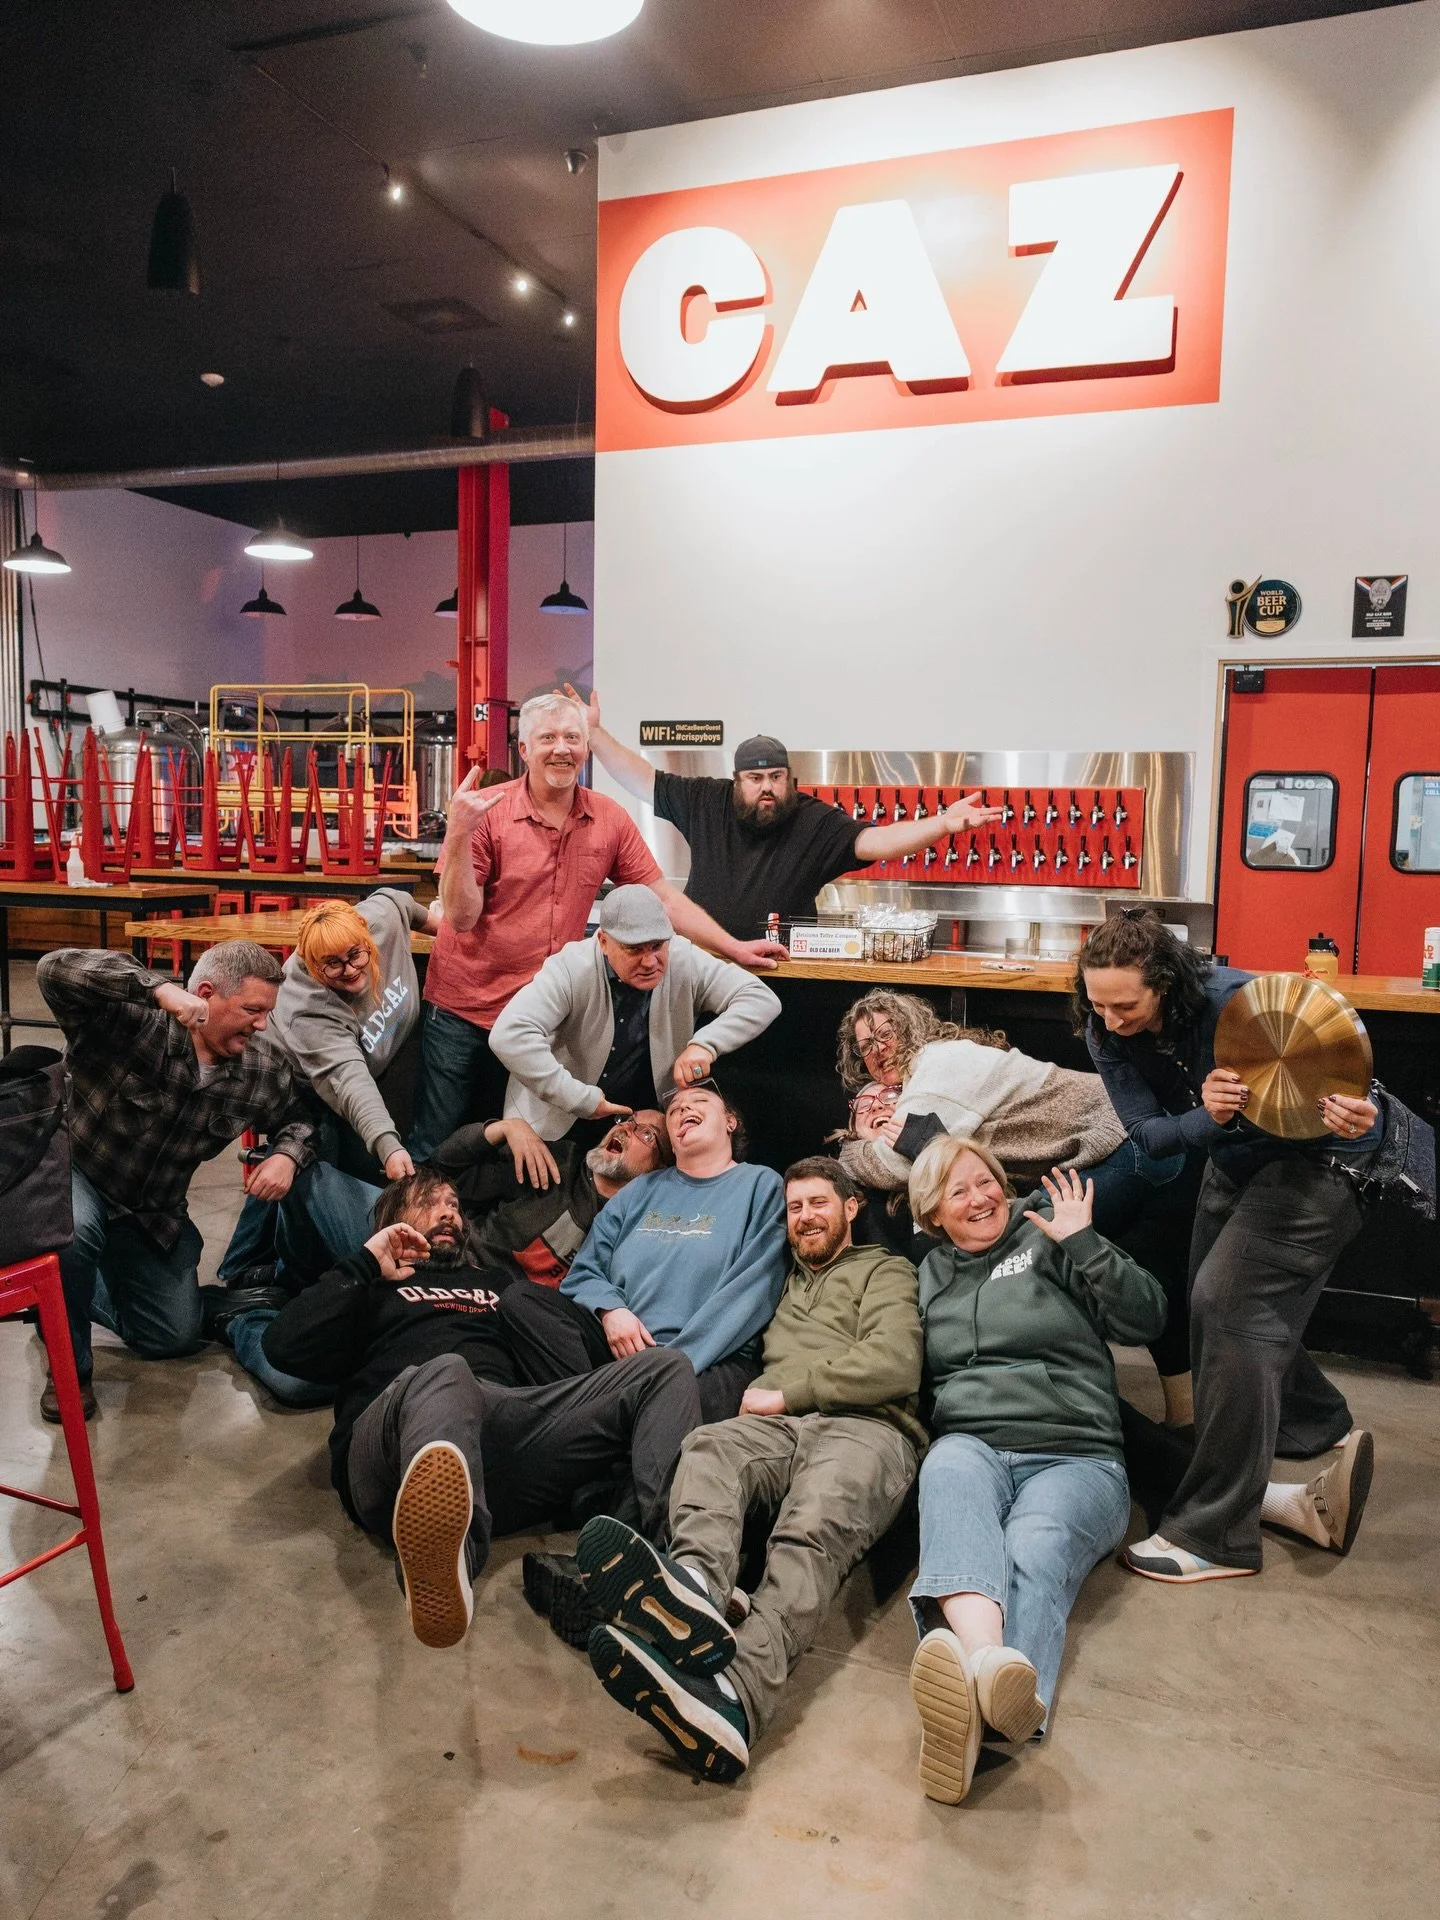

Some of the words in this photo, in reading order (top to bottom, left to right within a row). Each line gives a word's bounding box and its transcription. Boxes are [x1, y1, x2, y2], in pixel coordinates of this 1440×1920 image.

[617, 162, 1184, 414] CAZ
[1256, 596, 1287, 606] BEER
[1259, 605, 1284, 616] CUP
[641, 726, 675, 741] WIFI:
[675, 732, 721, 743] #crispyboys
